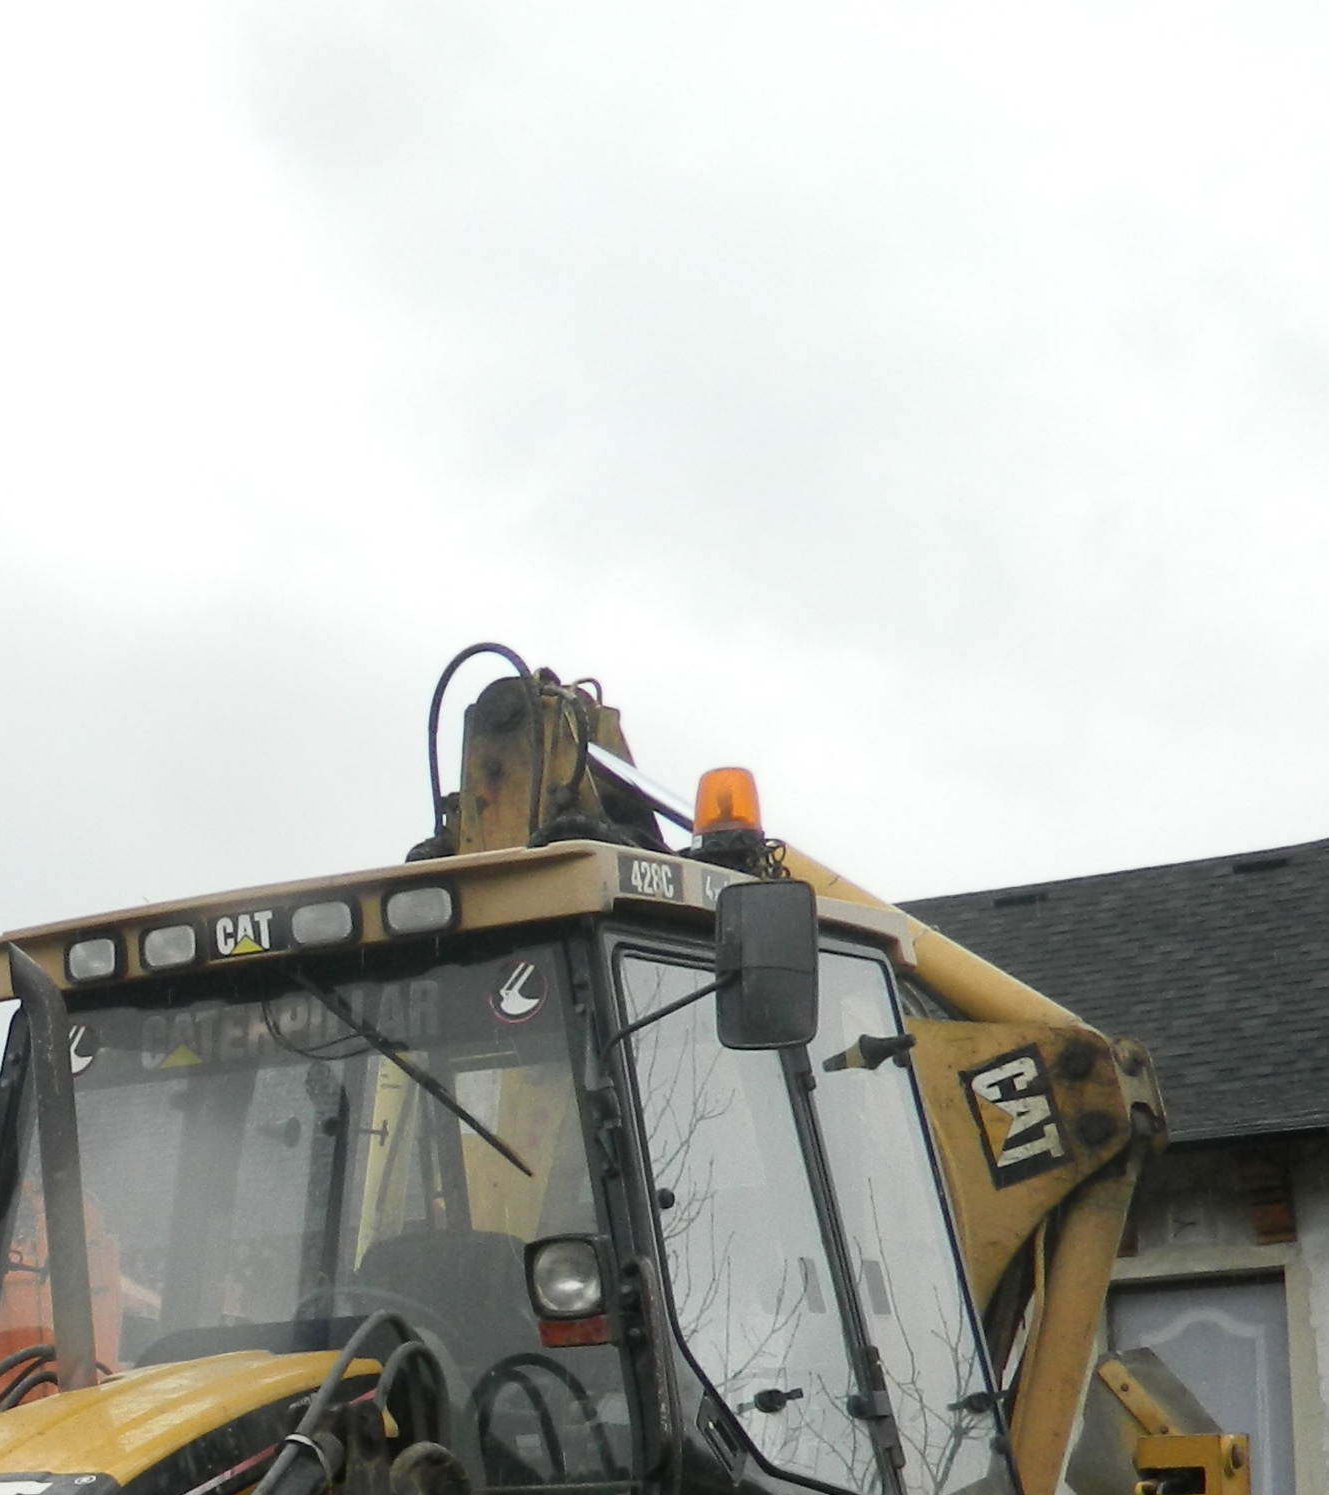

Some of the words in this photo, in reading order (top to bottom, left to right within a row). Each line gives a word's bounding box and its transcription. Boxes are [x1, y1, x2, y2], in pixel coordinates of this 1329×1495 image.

[630, 860, 675, 898] 428C
[216, 910, 273, 956] CAT
[971, 1056, 1065, 1168] CAT
